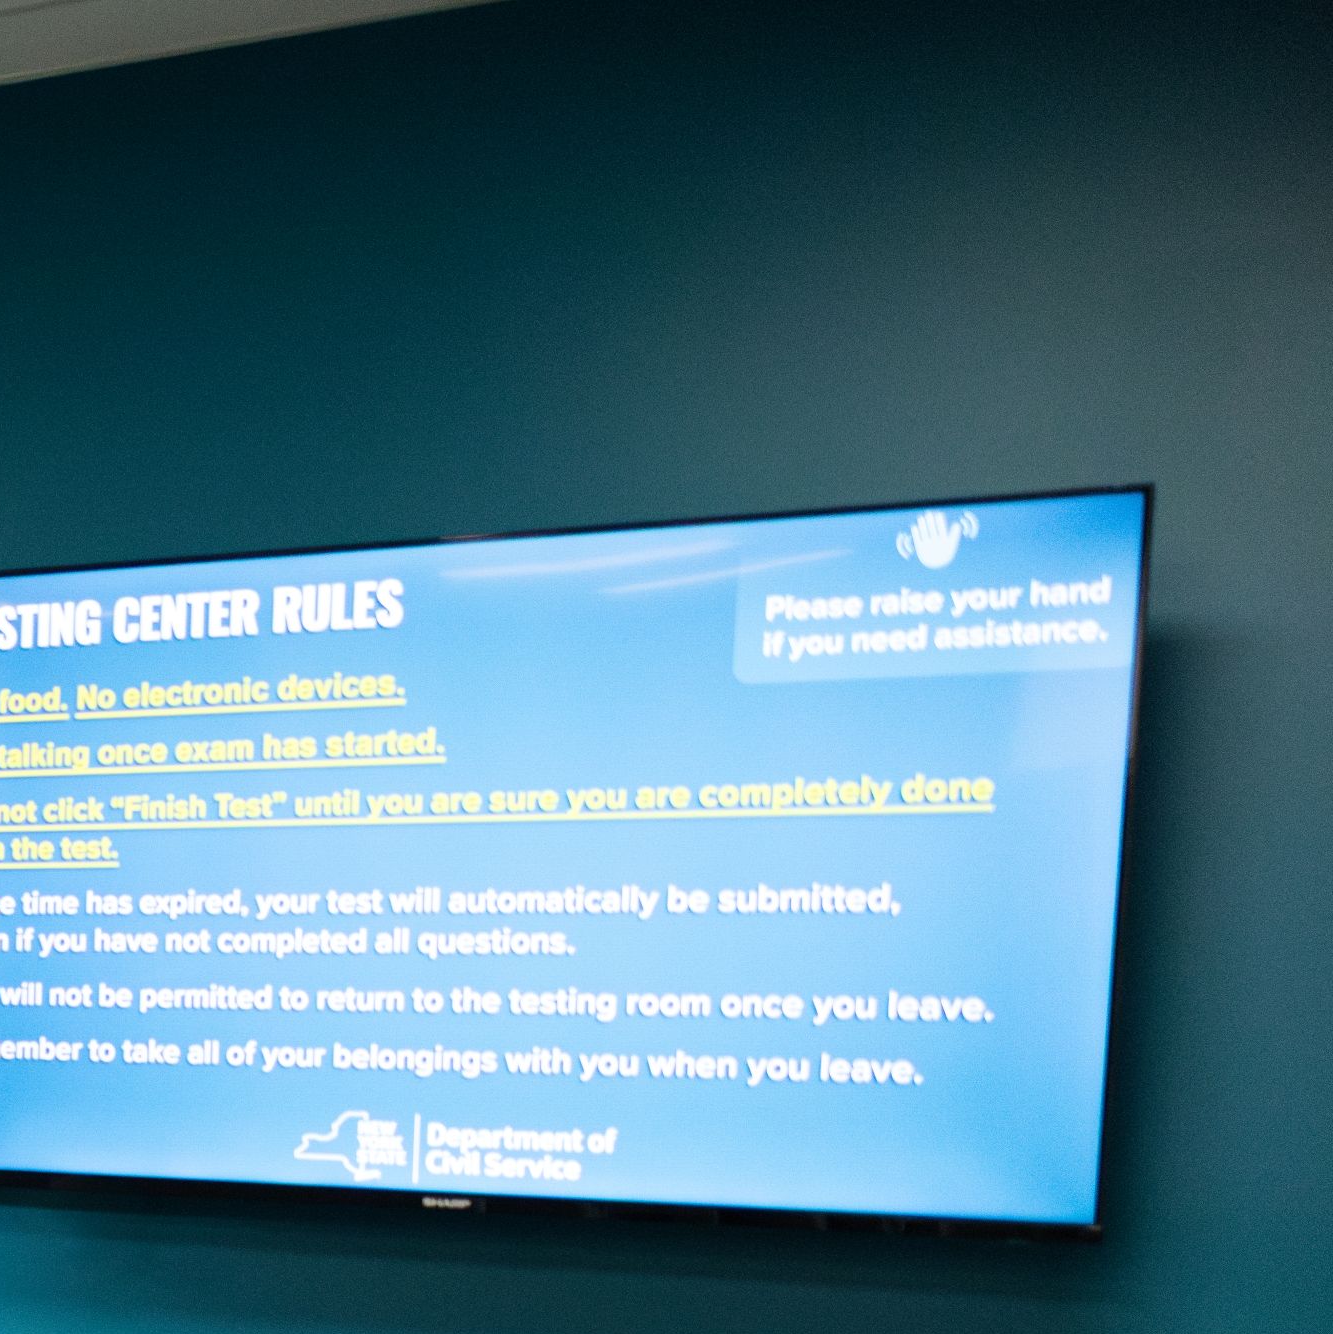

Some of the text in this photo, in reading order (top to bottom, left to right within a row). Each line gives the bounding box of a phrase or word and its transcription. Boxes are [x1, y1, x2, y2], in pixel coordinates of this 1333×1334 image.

[113, 589, 259, 644] CENTER
[272, 579, 404, 635] RULES
[765, 575, 1111, 622] Please raise your hand
[762, 619, 1108, 662] if you need assistance.
[76, 684, 116, 712] No
[123, 676, 269, 708] electronic
[277, 673, 406, 702] devices.
[97, 739, 168, 765] once
[175, 738, 253, 762] exam
[263, 733, 317, 759] has
[324, 728, 445, 758] started.
[88, 1037, 115, 1063] to
[122, 1037, 180, 1065] take
[187, 1040, 220, 1065] all
[226, 1040, 256, 1066] of
[261, 1045, 326, 1073] your
[333, 1043, 497, 1077] belongings
[506, 1048, 571, 1074] with
[579, 1053, 639, 1082] you
[647, 1050, 737, 1079] when
[746, 1057, 809, 1087] you
[820, 1052, 923, 1085] leave.
[427, 1121, 618, 1154] Department of
[425, 1151, 581, 1181] Civil Service
